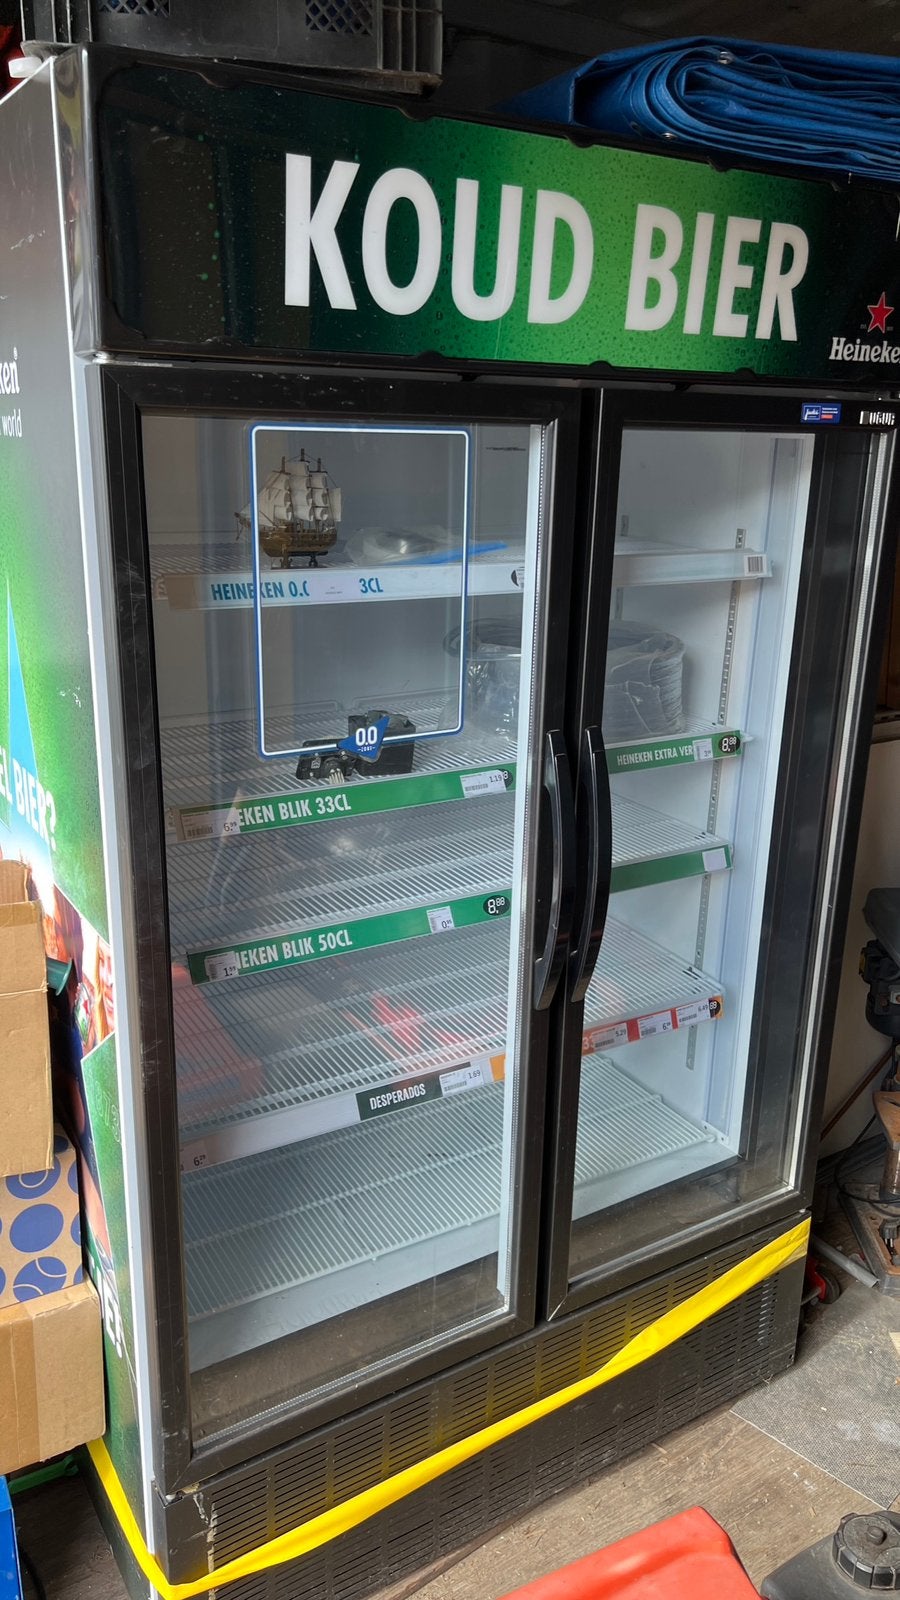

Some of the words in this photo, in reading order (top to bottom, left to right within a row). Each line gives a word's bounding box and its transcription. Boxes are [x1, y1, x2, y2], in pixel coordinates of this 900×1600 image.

[285, 153, 594, 323] KOUD
[624, 203, 809, 342] BIER
[829, 337, 900, 364] Heineke
[2, 408, 22, 437] world
[355, 726, 378, 746] 0.0
[617, 750, 653, 766] HEINEKEN
[654, 747, 678, 760] EXTRA
[13, 758, 57, 851] BIER?
[278, 799, 312, 820] BLIK
[315, 794, 352, 814] 33CL
[487, 897, 506, 914] 8.88
[282, 937, 315, 959] BLIK
[319, 929, 353, 952] 50CL
[369, 1083, 426, 1111] DESPERADOS
